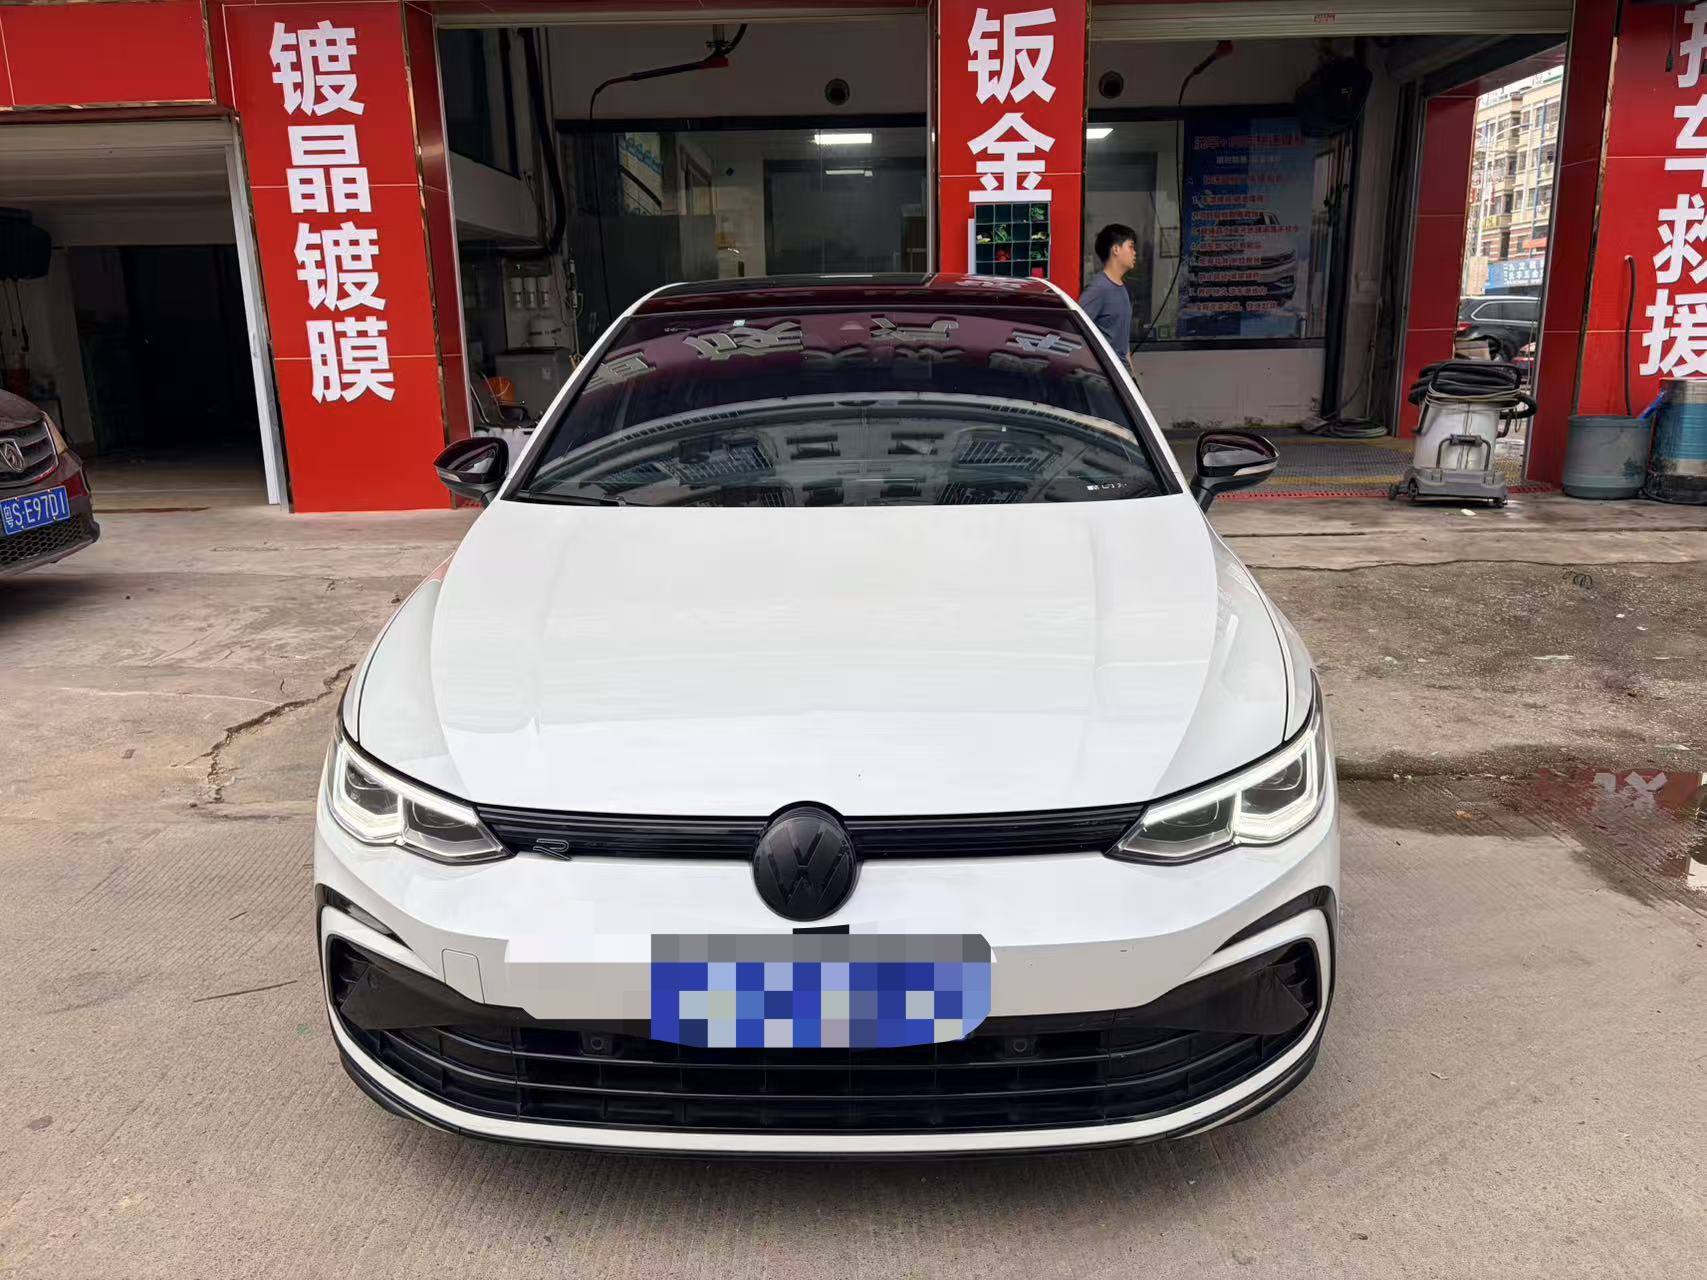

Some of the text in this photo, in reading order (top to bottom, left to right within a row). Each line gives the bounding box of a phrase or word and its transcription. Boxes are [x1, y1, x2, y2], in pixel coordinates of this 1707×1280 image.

[269, 20, 397, 403] 镀晶镀膜
[967, 7, 1057, 202] 钣金
